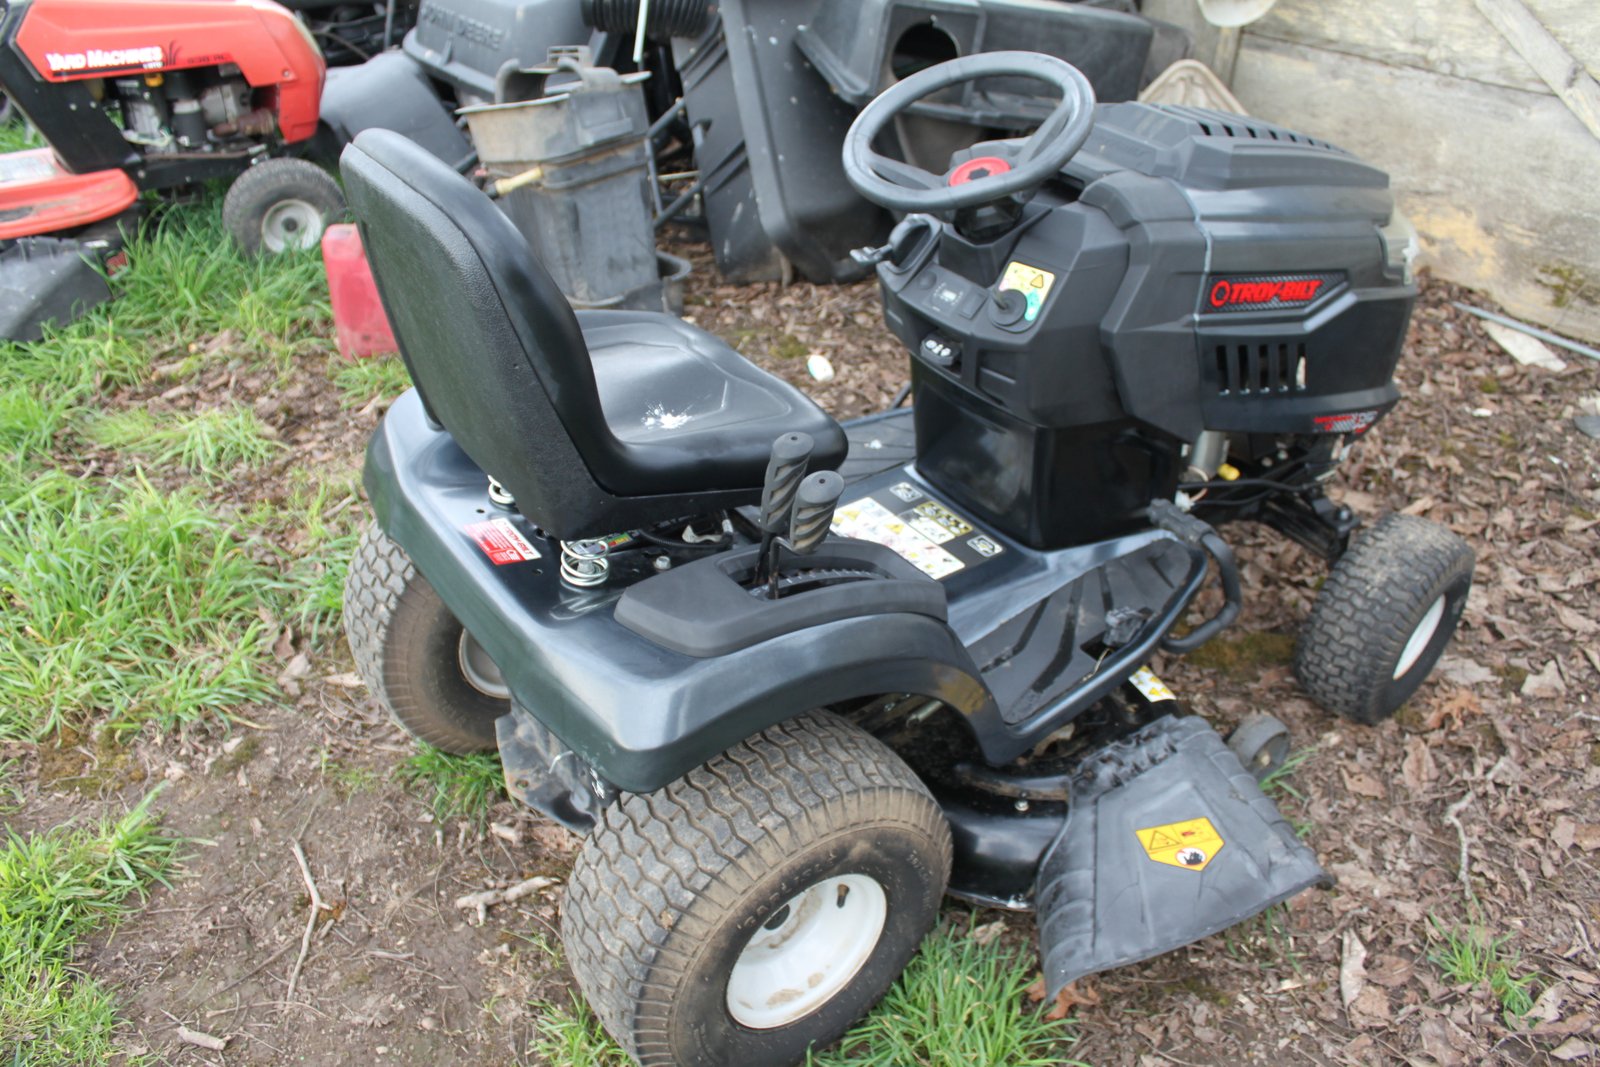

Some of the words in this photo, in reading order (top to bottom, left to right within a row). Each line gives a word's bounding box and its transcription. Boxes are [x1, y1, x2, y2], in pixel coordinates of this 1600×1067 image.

[454, 14, 502, 52] DEERE
[46, 53, 86, 71] YARD
[87, 46, 163, 67] MACHINES
[1230, 280, 1322, 303] TROY-BILT
